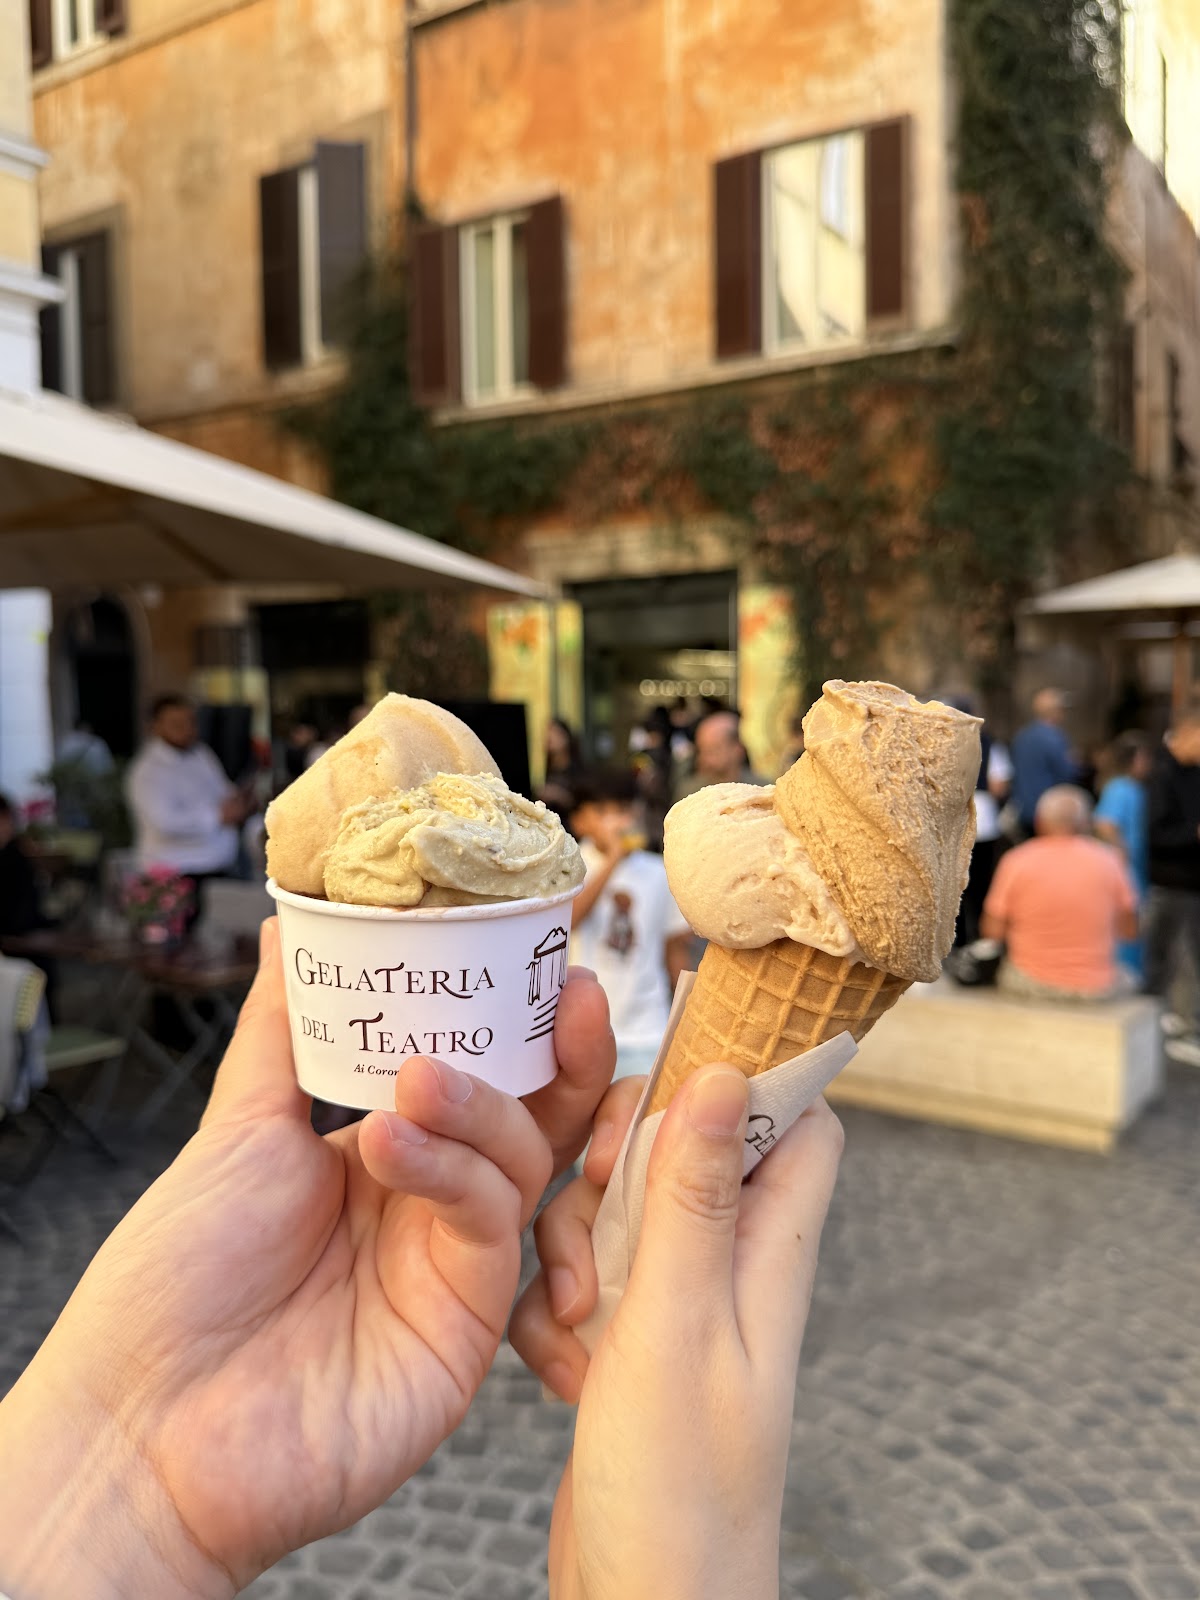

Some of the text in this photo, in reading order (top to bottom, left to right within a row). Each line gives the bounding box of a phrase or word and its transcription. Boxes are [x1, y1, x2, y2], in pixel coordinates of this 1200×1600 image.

[295, 947, 496, 999] GELATERIA
[301, 1011, 494, 1056] DEL TEATRO
[353, 1063, 365, 1073] Ai
